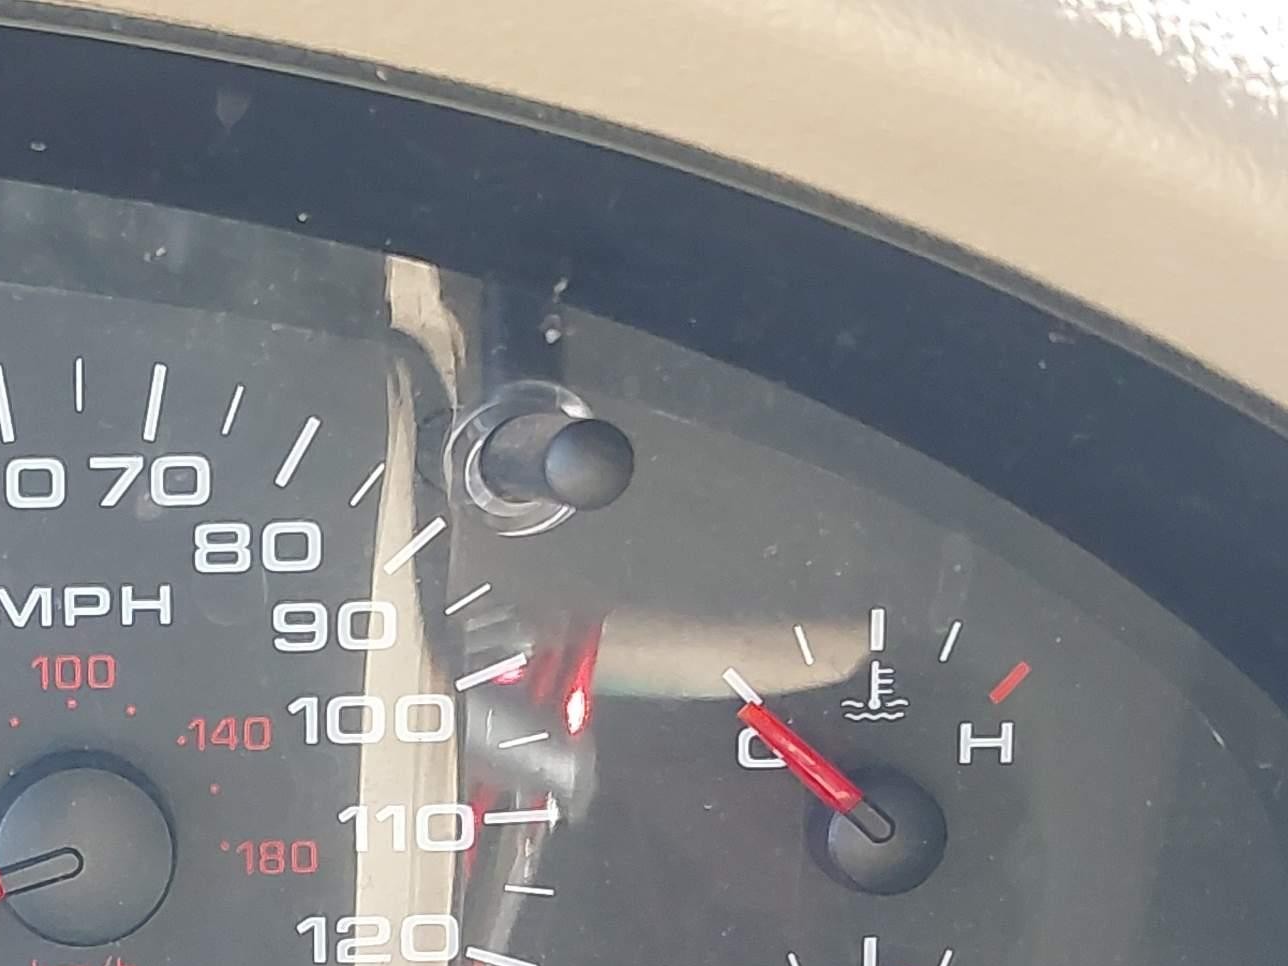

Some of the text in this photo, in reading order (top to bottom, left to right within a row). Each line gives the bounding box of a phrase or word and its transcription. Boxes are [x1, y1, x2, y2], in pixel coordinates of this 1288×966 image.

[88, 455, 211, 507] 70
[194, 521, 323, 573] 80
[272, 601, 398, 652] 90
[31, 655, 117, 691] 100
[188, 716, 273, 752] 140
[287, 694, 455, 745] 100
[958, 722, 1014, 764] H
[337, 803, 476, 852] 110
[239, 840, 319, 876] 180
[295, 913, 460, 964] 120
